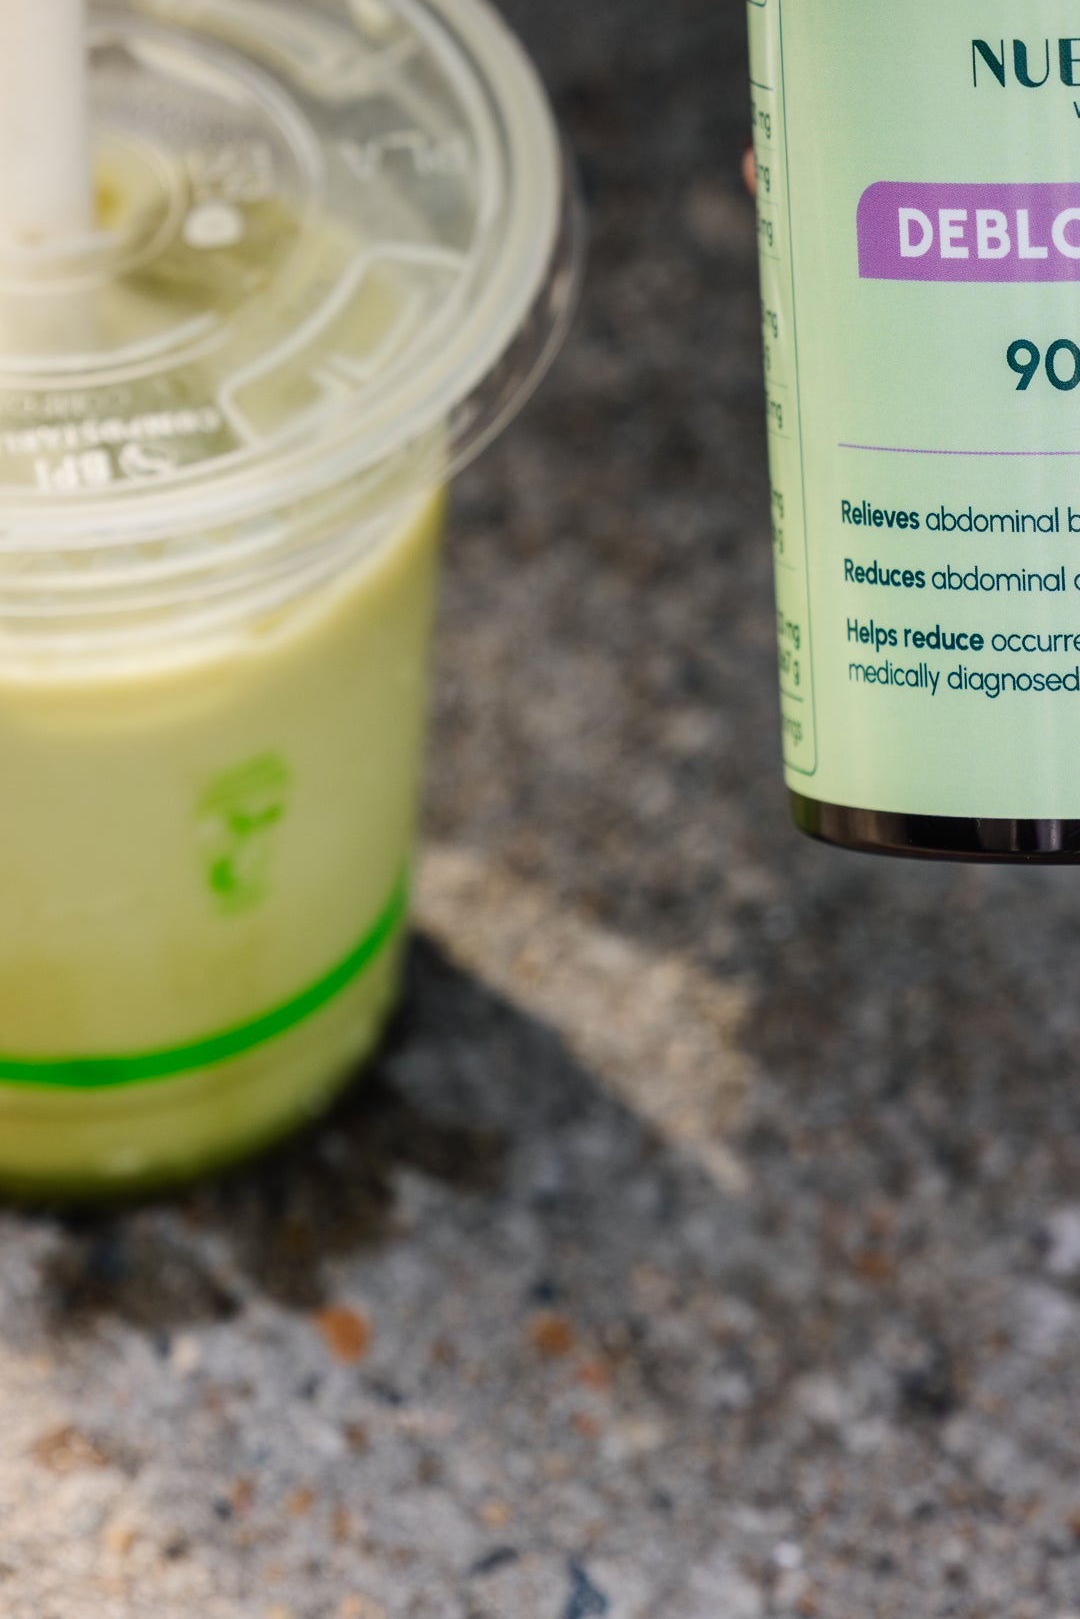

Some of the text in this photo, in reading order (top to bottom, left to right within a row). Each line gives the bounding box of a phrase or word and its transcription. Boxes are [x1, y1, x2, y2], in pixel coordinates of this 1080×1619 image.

[841, 499, 921, 531] Relieves
[925, 505, 1060, 533] abdominal
[844, 558, 926, 589] Reduces
[931, 564, 1066, 592] abdominal
[846, 618, 898, 653] Helps
[904, 624, 985, 652] reduce
[848, 659, 941, 697] medically
[946, 664, 1080, 699] diagnosed
